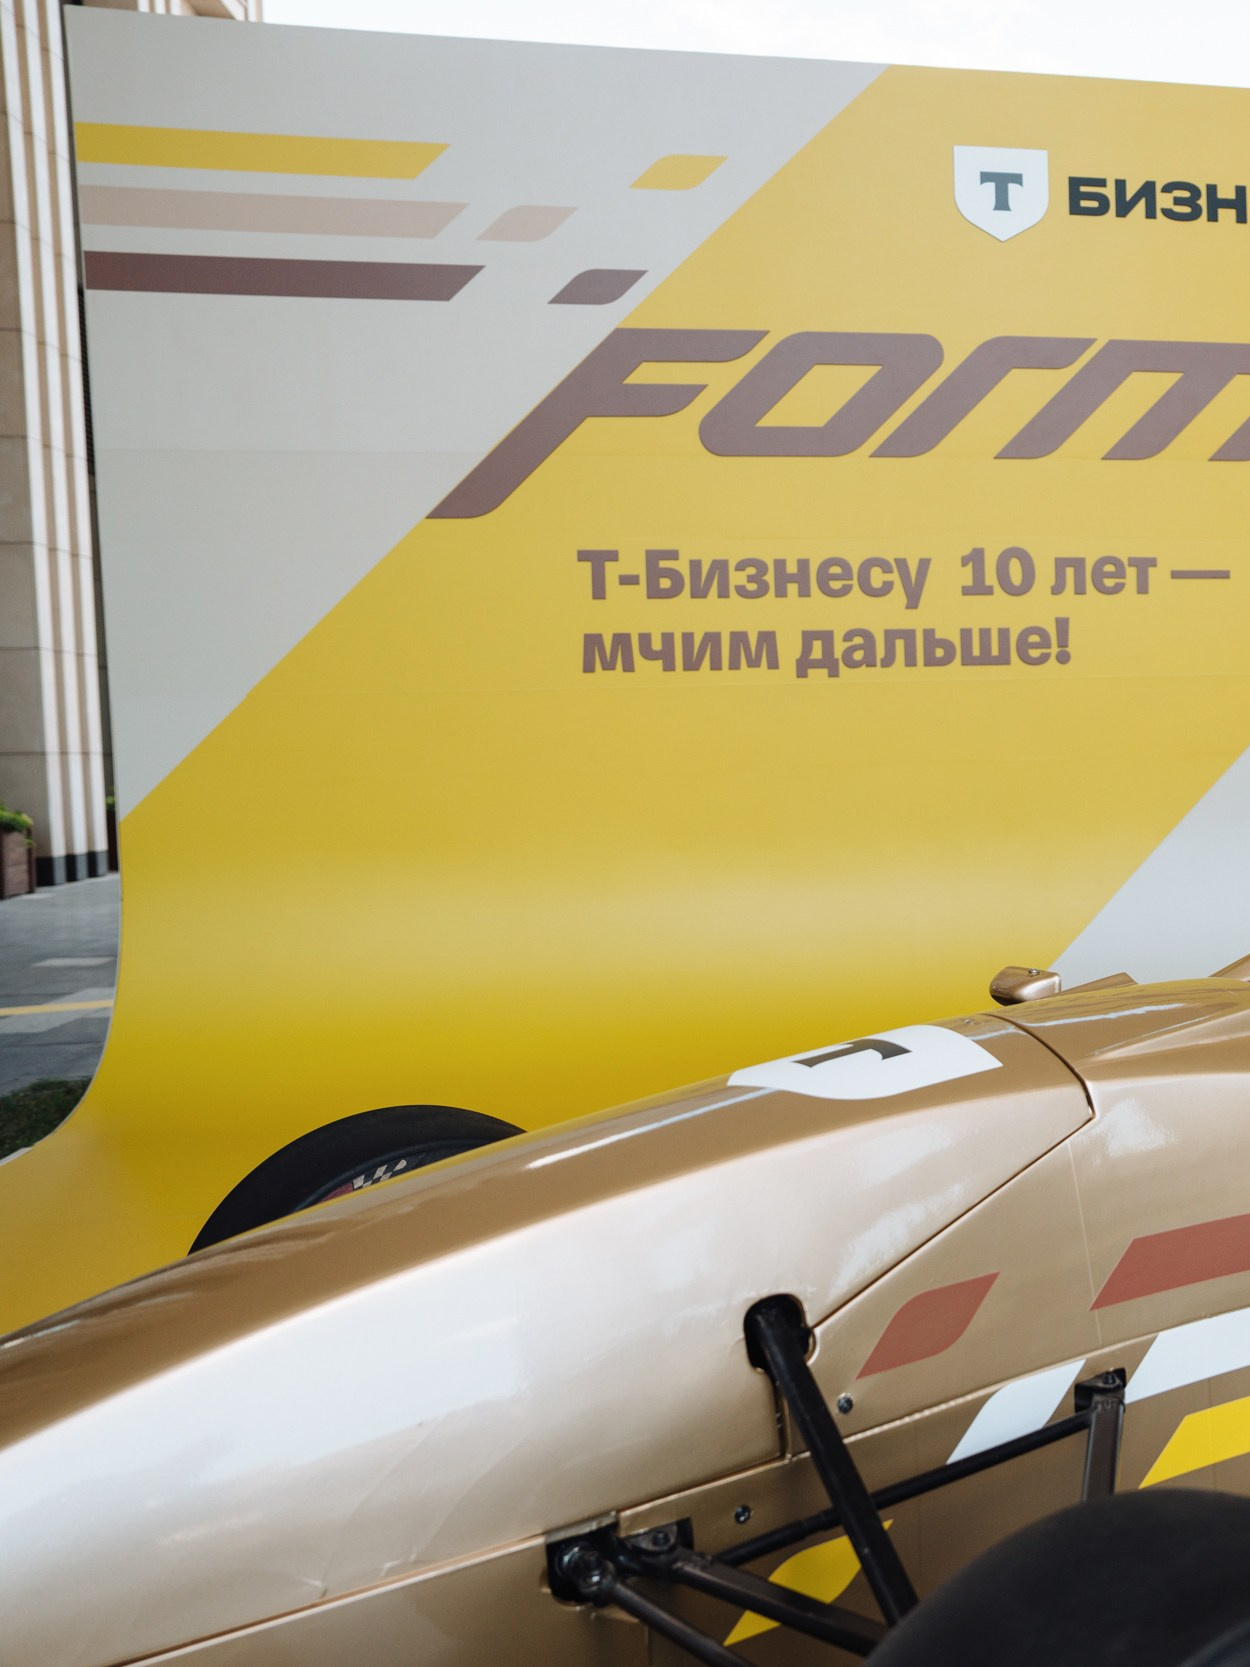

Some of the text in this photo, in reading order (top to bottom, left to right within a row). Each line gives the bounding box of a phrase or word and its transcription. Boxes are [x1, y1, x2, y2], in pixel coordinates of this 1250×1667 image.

[576, 547, 932, 610] Т-Бизнесу
[959, 545, 1036, 597] 10
[1050, 554, 1158, 596] лет
[581, 616, 1072, 679] мчим дальше!
